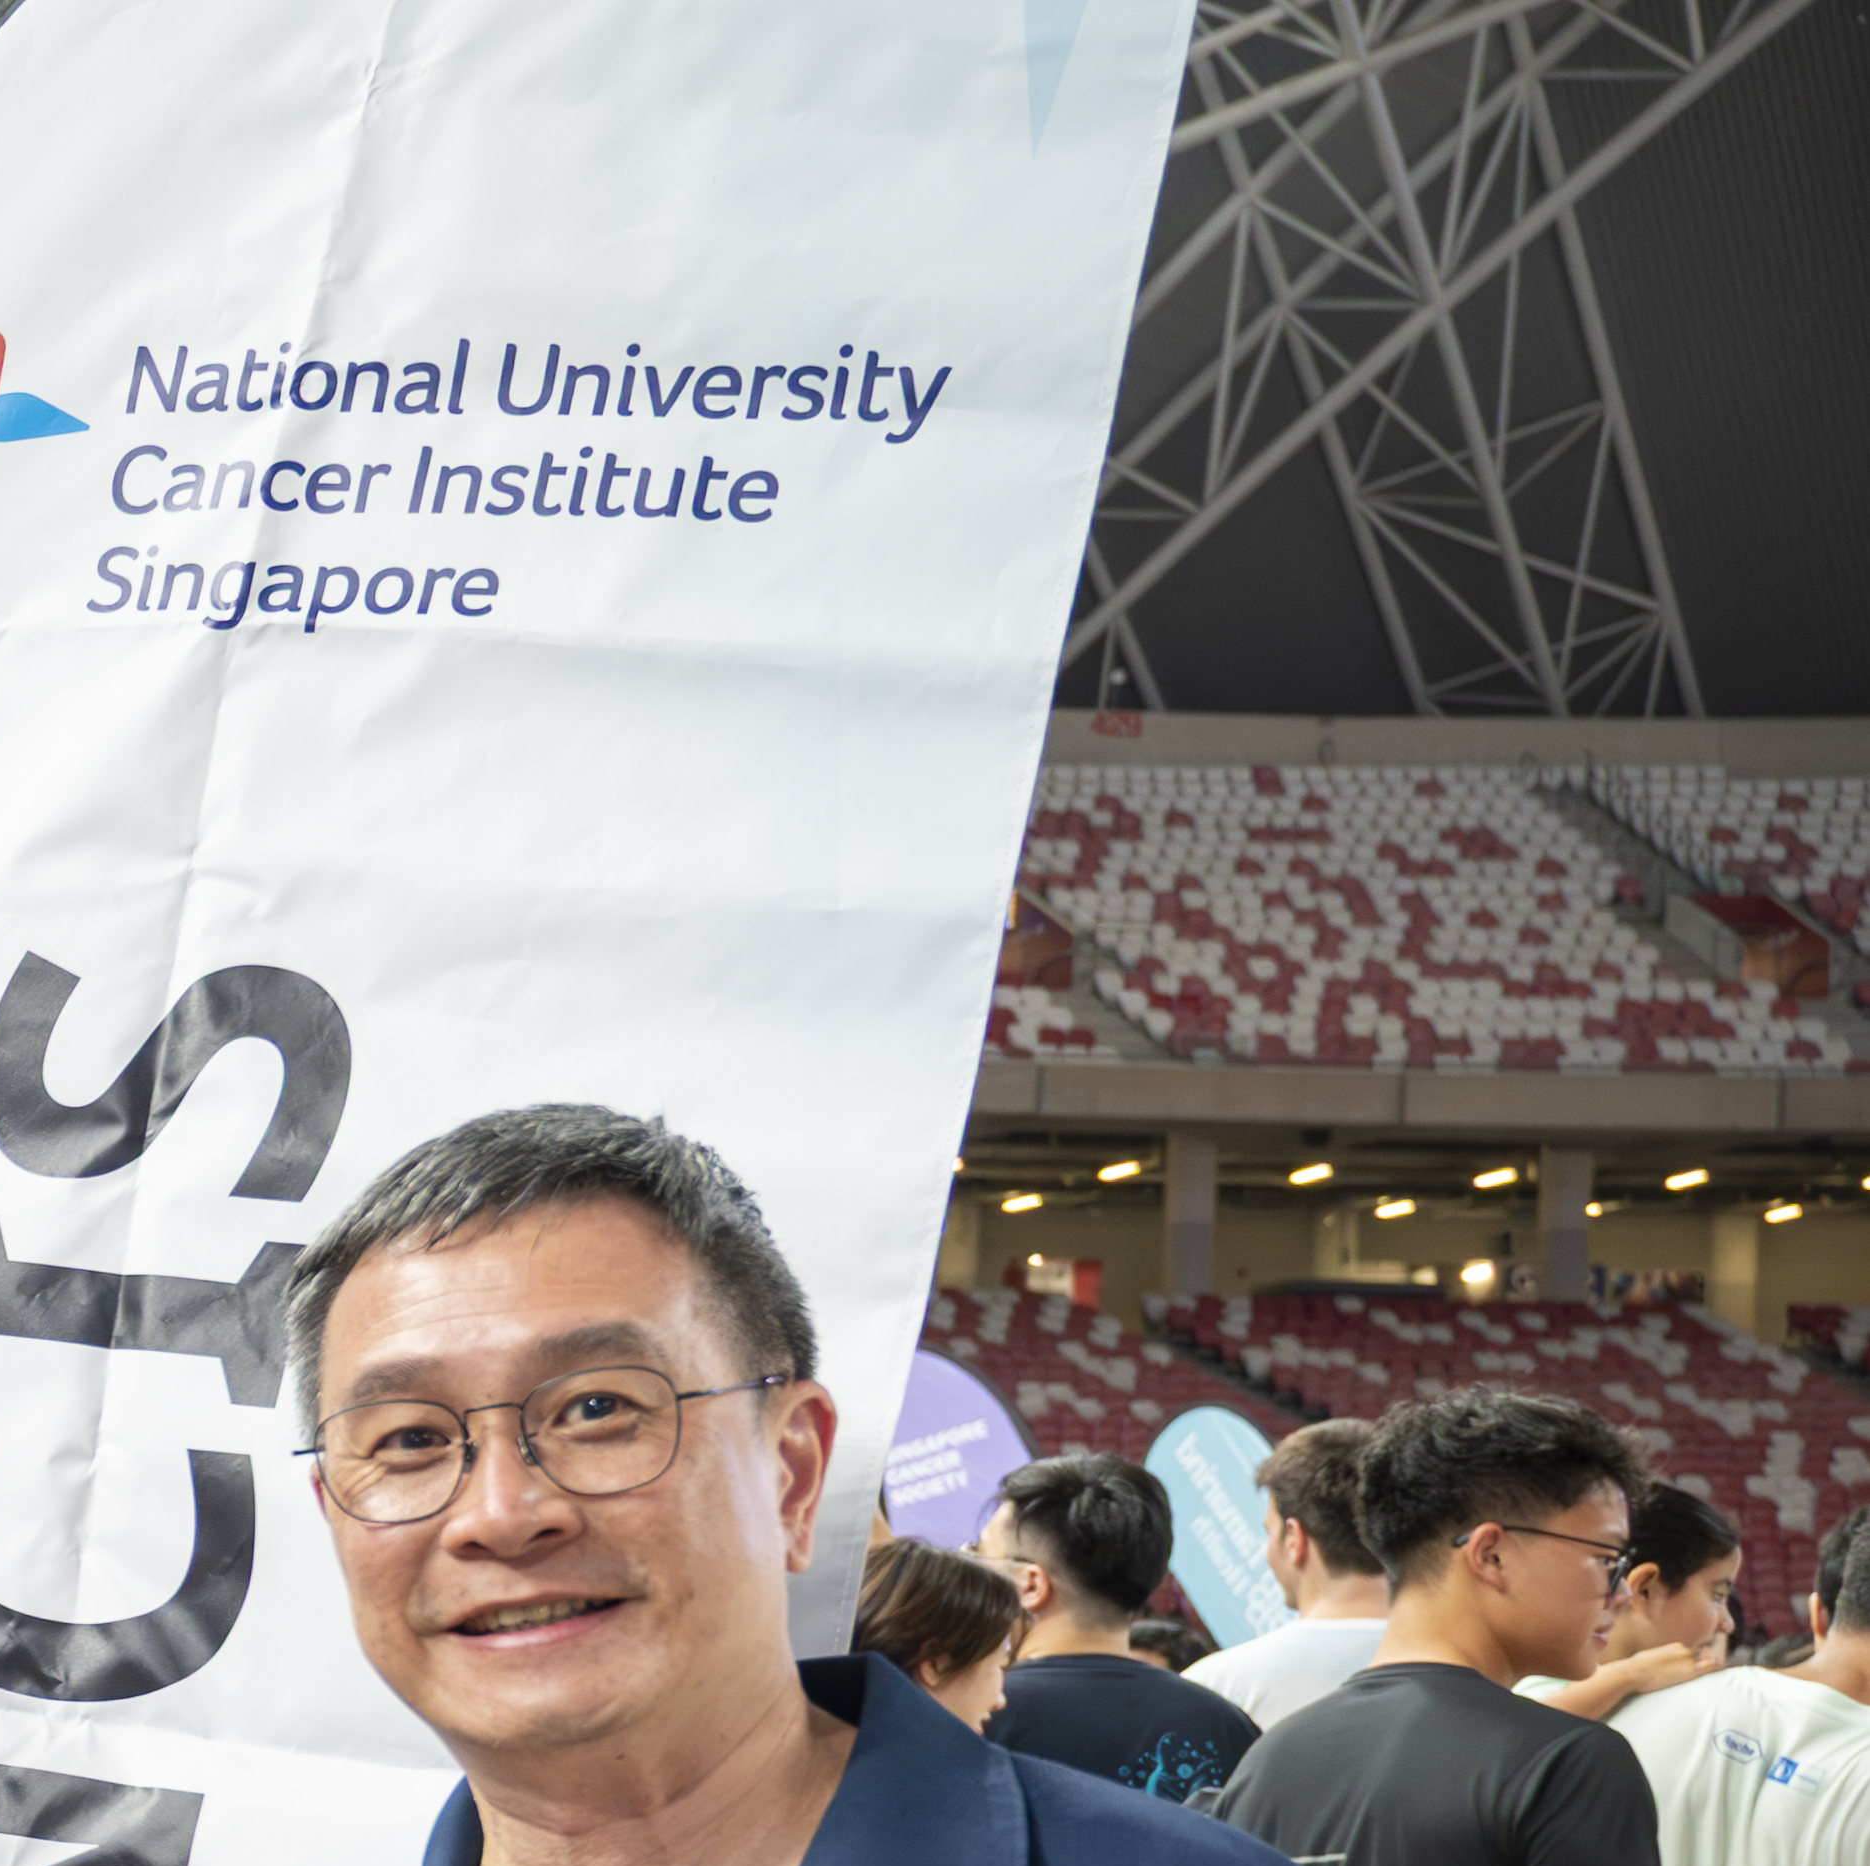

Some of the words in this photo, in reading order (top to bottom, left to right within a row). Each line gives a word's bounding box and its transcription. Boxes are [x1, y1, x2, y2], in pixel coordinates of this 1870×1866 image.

[124, 339, 469, 419] National
[497, 340, 953, 444] University
[109, 445, 392, 518] Cancer
[407, 448, 780, 524] Institute
[86, 545, 501, 634] Singapore
